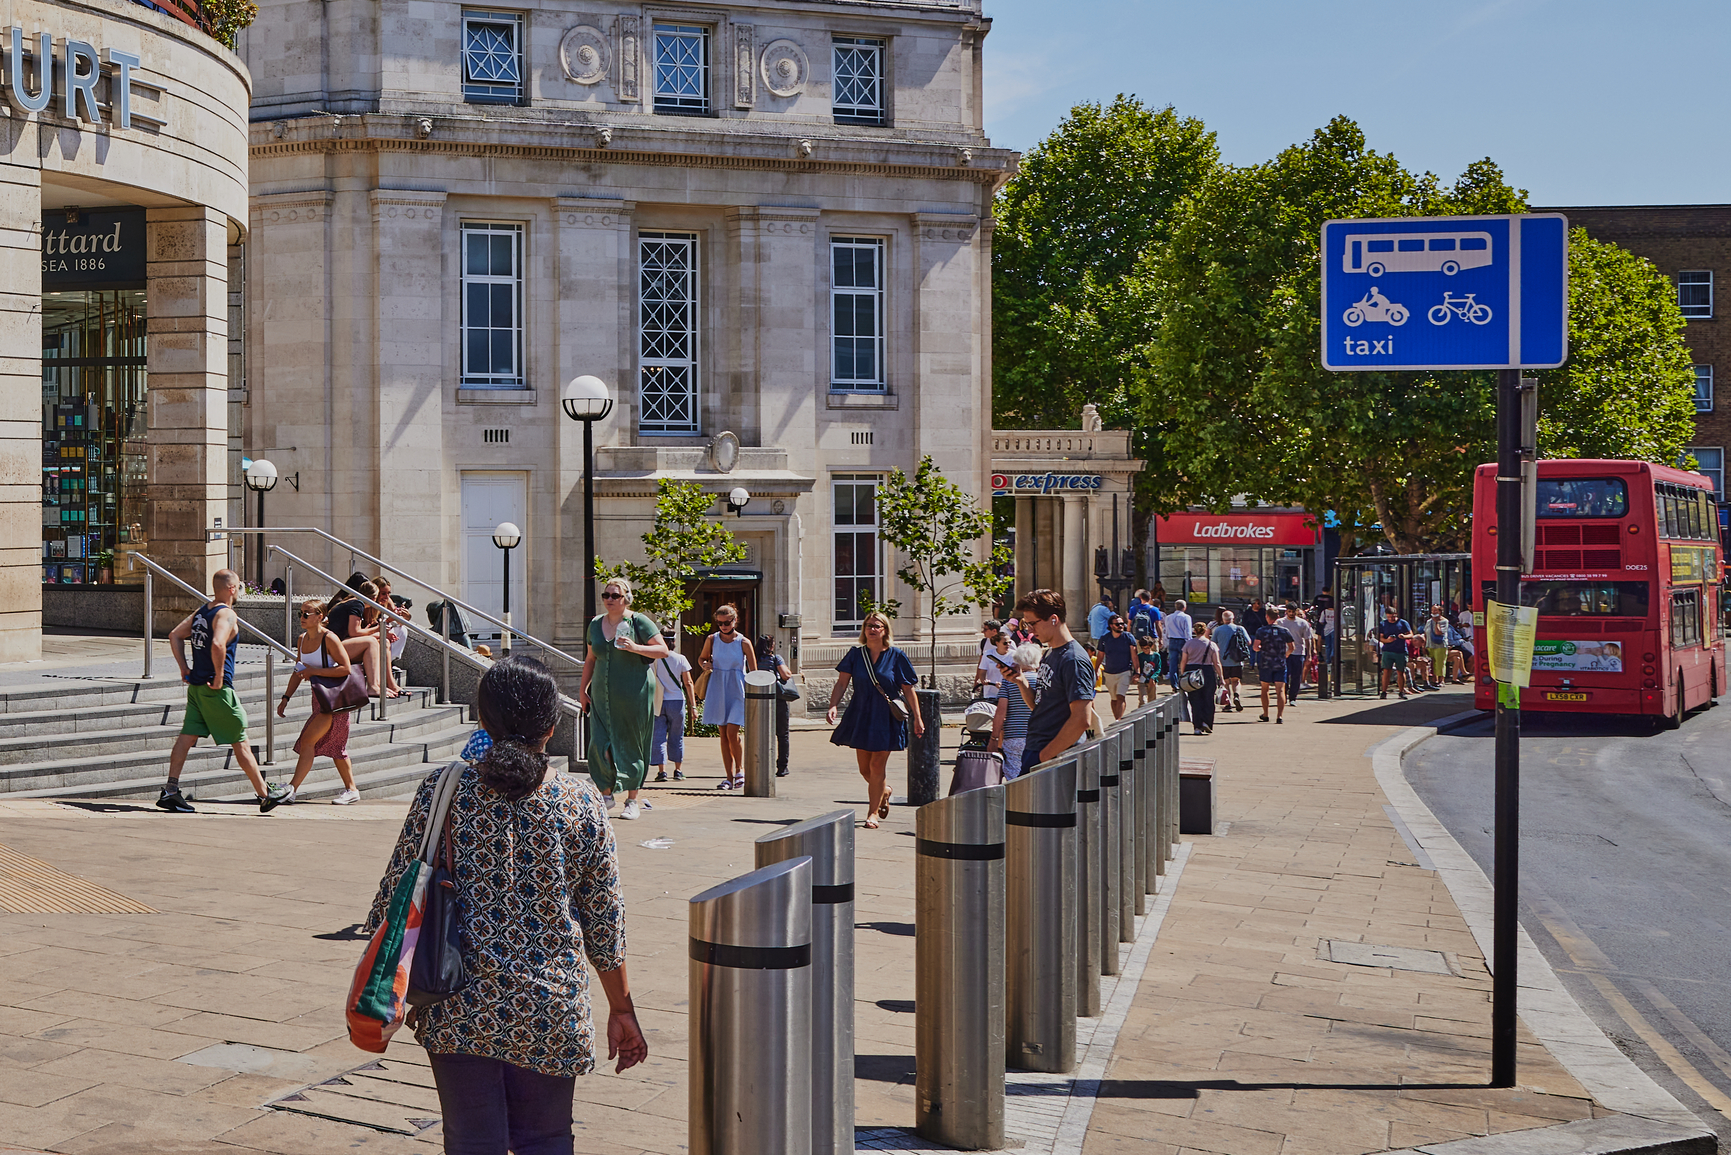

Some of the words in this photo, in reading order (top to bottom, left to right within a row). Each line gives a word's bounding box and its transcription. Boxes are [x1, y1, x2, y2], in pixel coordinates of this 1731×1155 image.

[75, 257, 106, 271] 1886
[1343, 334, 1394, 356] taxi
[1015, 471, 1101, 495] express
[1193, 522, 1275, 538] Ladbrokes
